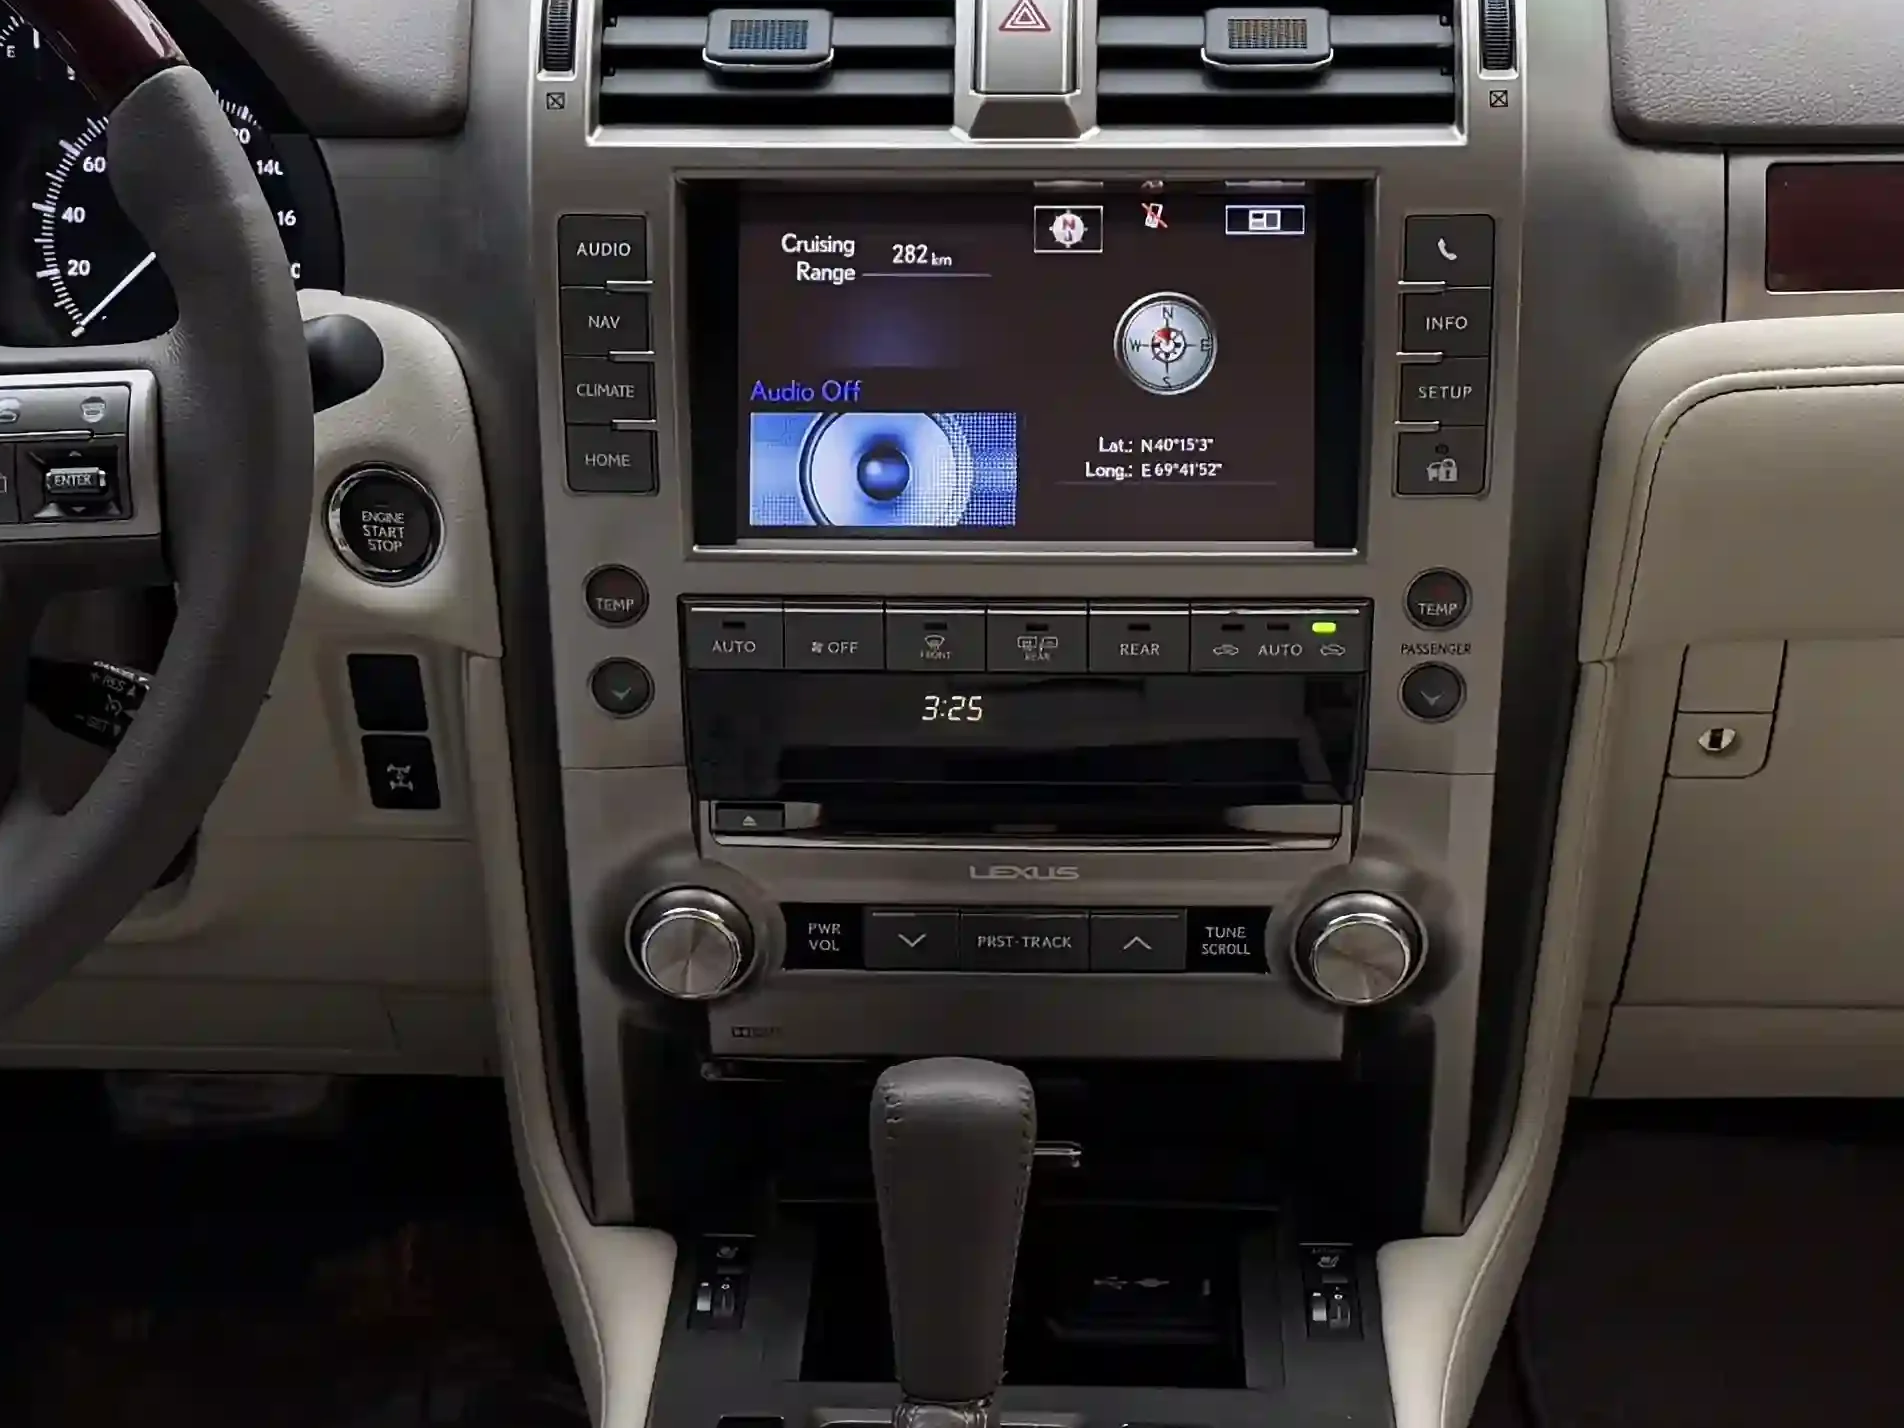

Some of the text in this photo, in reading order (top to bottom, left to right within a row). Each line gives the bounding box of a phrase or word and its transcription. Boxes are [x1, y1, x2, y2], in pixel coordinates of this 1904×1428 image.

[7, 45, 16, 58] E
[83, 156, 106, 173] 60
[62, 206, 85, 223] 40
[576, 242, 631, 257] AUDIO
[781, 232, 856, 257] Cruising
[892, 244, 953, 266] 282 km
[67, 260, 90, 276] 20
[796, 261, 856, 285] Range
[588, 316, 621, 329] NAV
[1426, 316, 1468, 331] INFO
[576, 383, 635, 398] CLIMATE
[750, 379, 863, 403] Audio Off
[1418, 385, 1473, 400] SETUP
[585, 453, 631, 467] HOME
[54, 474, 92, 487] ENTER
[361, 511, 405, 524] ENGINE
[362, 524, 405, 539] START
[367, 538, 403, 552] STOP
[596, 597, 634, 611] TEMP
[1419, 603, 1458, 615] TEMP
[712, 640, 756, 654] AUTO
[828, 641, 859, 654] OFF
[1119, 643, 1161, 656] REAR
[1258, 644, 1303, 656] AUTO
[1401, 643, 1472, 655] PASSENGER
[921, 696, 983, 721] 3:25
[969, 865, 1080, 881] LEXUS
[808, 923, 841, 935] PWR
[1205, 926, 1246, 939] TUNE
[809, 939, 840, 952] VOL
[1201, 943, 1250, 955] SCROLL
